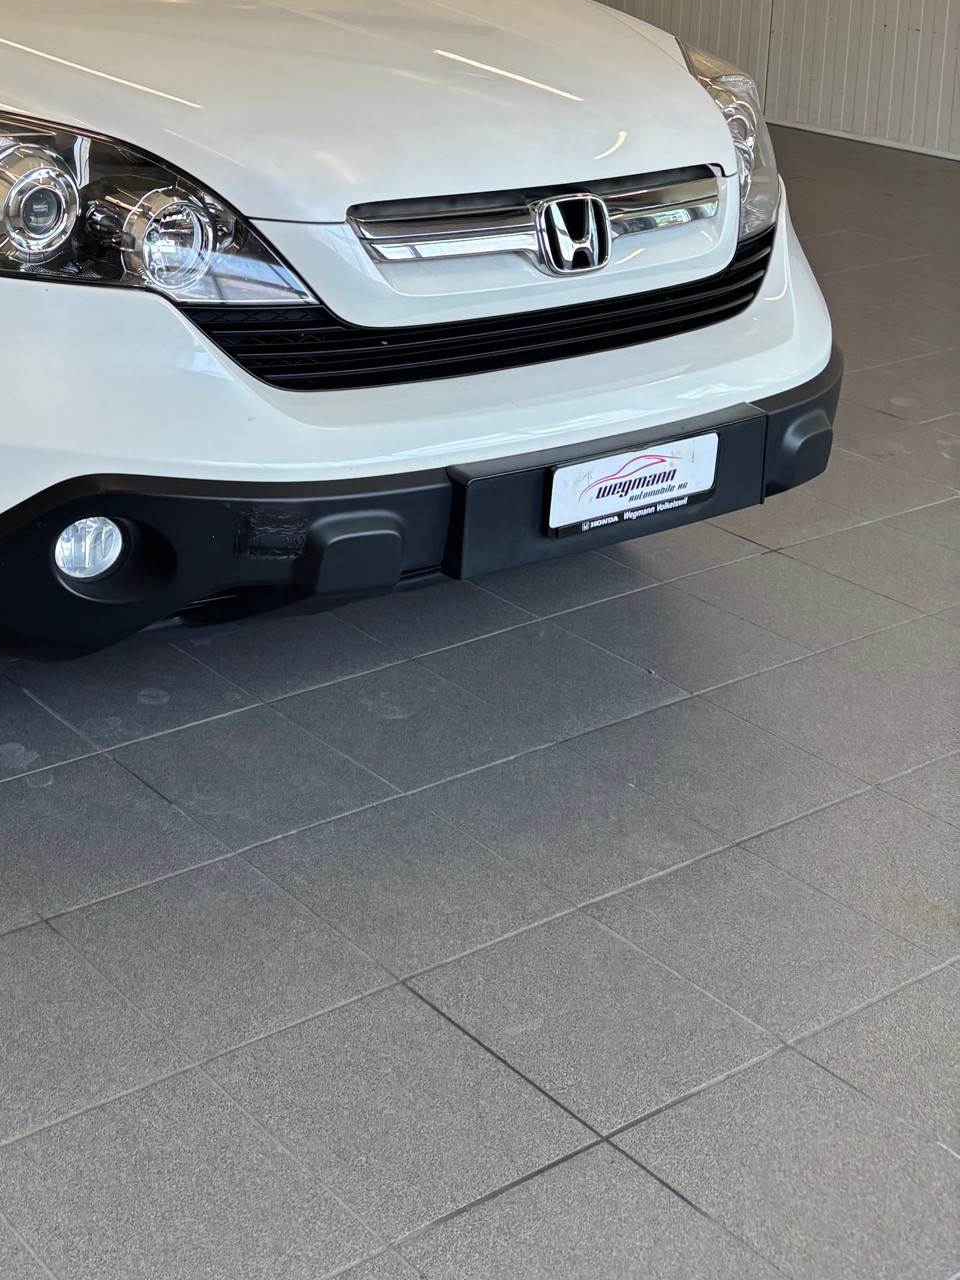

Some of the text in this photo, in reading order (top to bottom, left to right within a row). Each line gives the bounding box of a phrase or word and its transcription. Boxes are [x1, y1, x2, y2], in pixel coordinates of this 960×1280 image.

[595, 468, 677, 499] wegmann
[628, 484, 676, 502] automobile
[590, 496, 689, 528] HONDA Wegmann Volketswil
